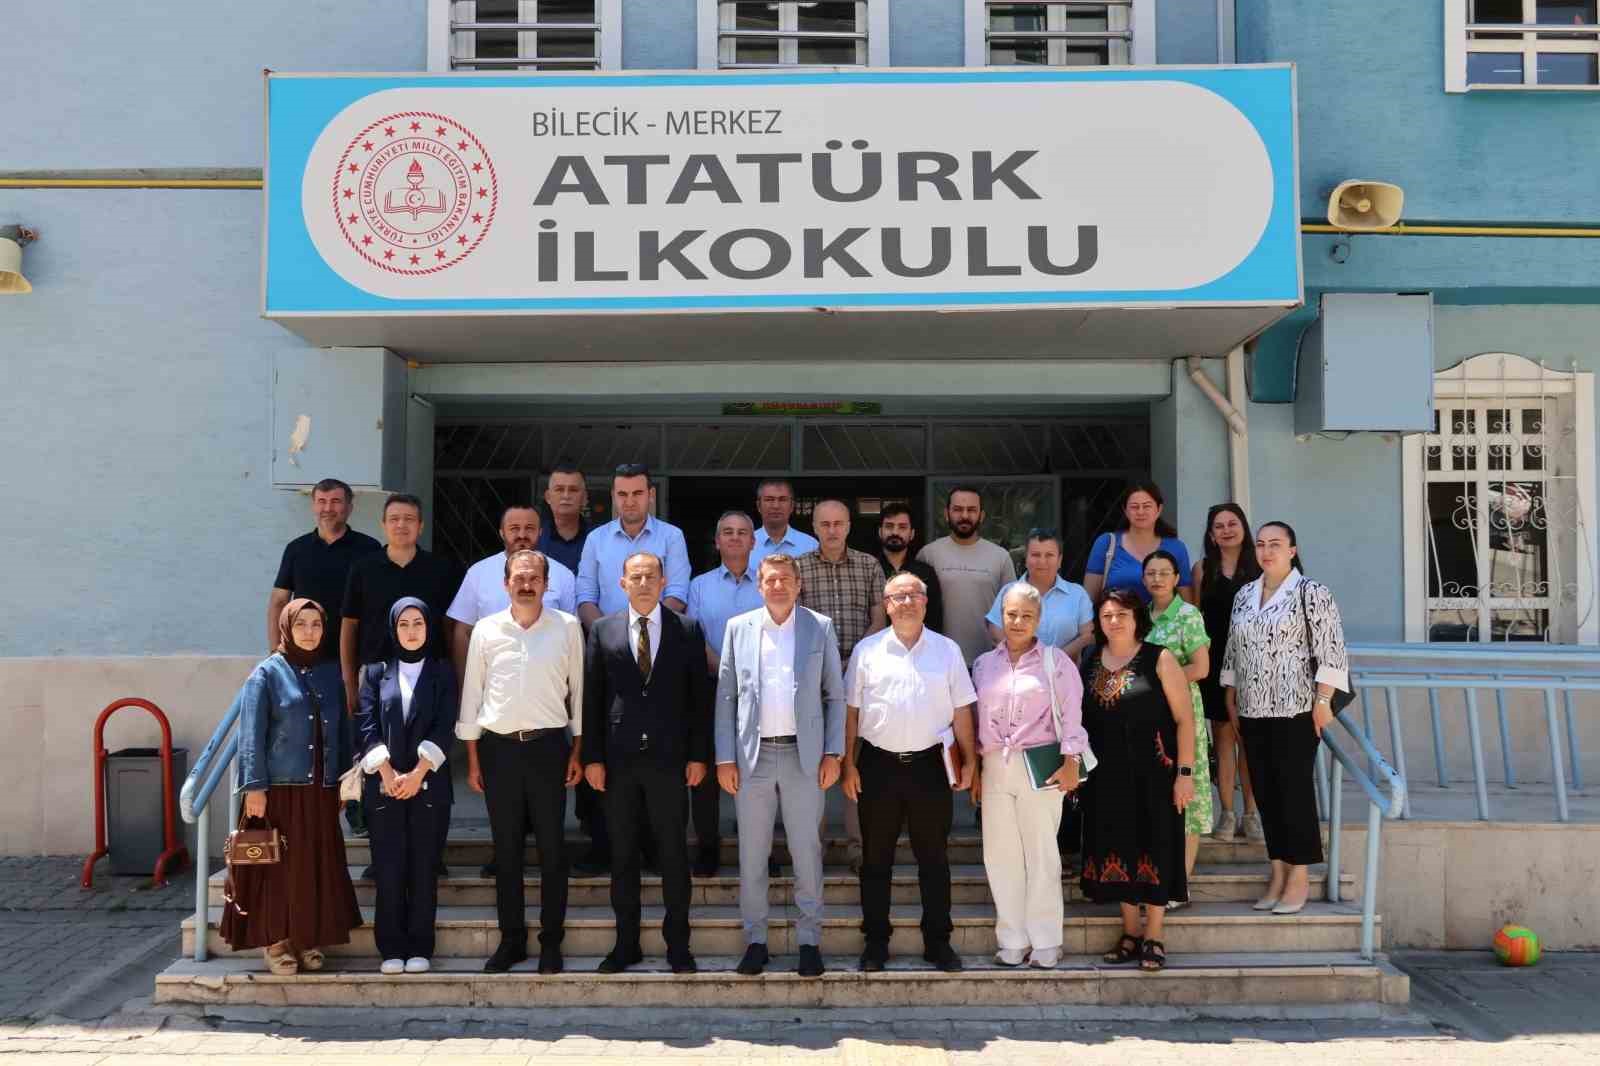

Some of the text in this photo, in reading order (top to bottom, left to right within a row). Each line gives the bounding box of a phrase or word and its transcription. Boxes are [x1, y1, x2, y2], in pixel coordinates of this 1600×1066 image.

[532, 106, 639, 137] BİLECİK
[666, 110, 783, 135] MERKEZ
[532, 139, 1042, 206] ATATÜRK
[537, 219, 1099, 282] İLKOKULU
